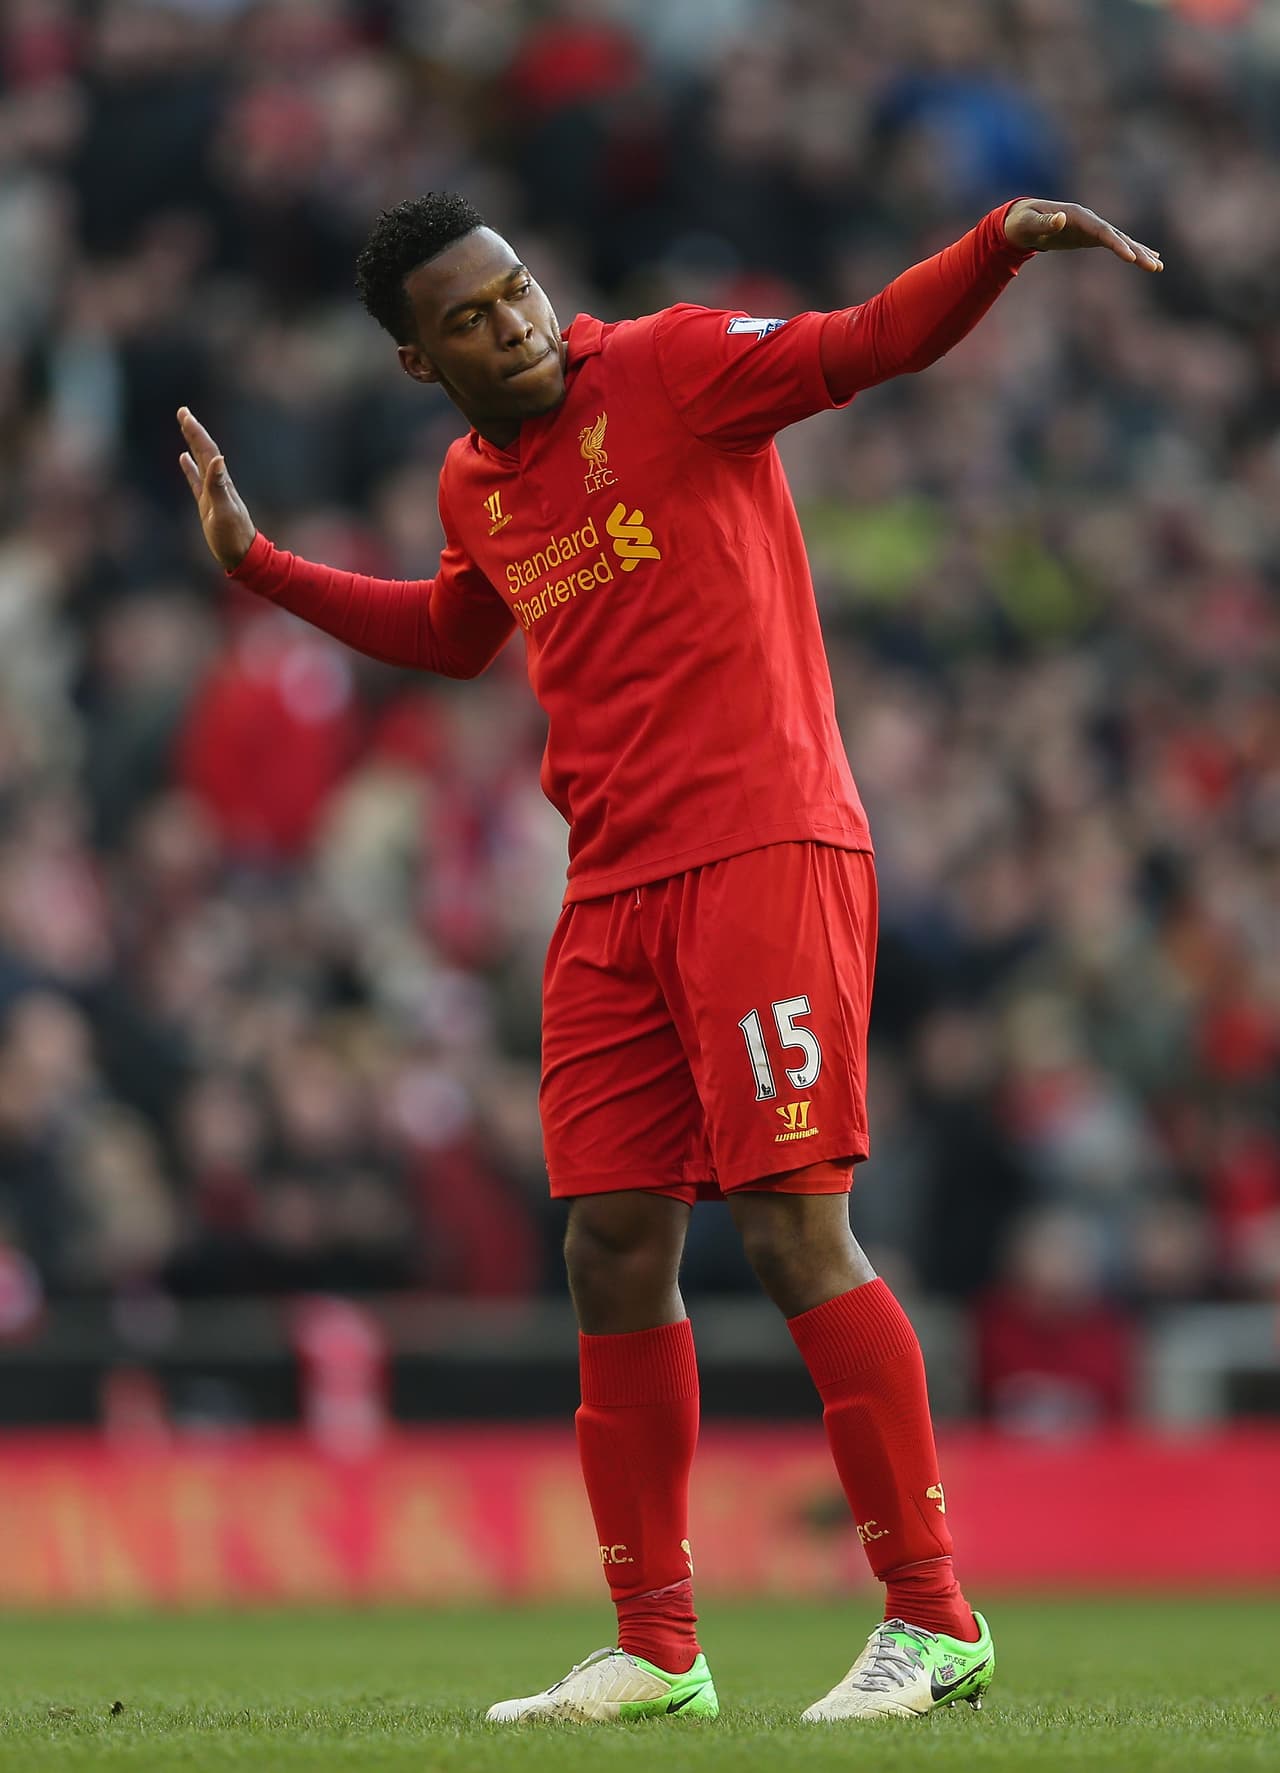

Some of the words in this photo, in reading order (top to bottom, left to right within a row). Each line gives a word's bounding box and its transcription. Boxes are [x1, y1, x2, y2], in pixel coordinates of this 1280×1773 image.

[584, 470, 618, 494] L.F.C.
[506, 517, 599, 594] Standard
[738, 995, 822, 1101] 15
